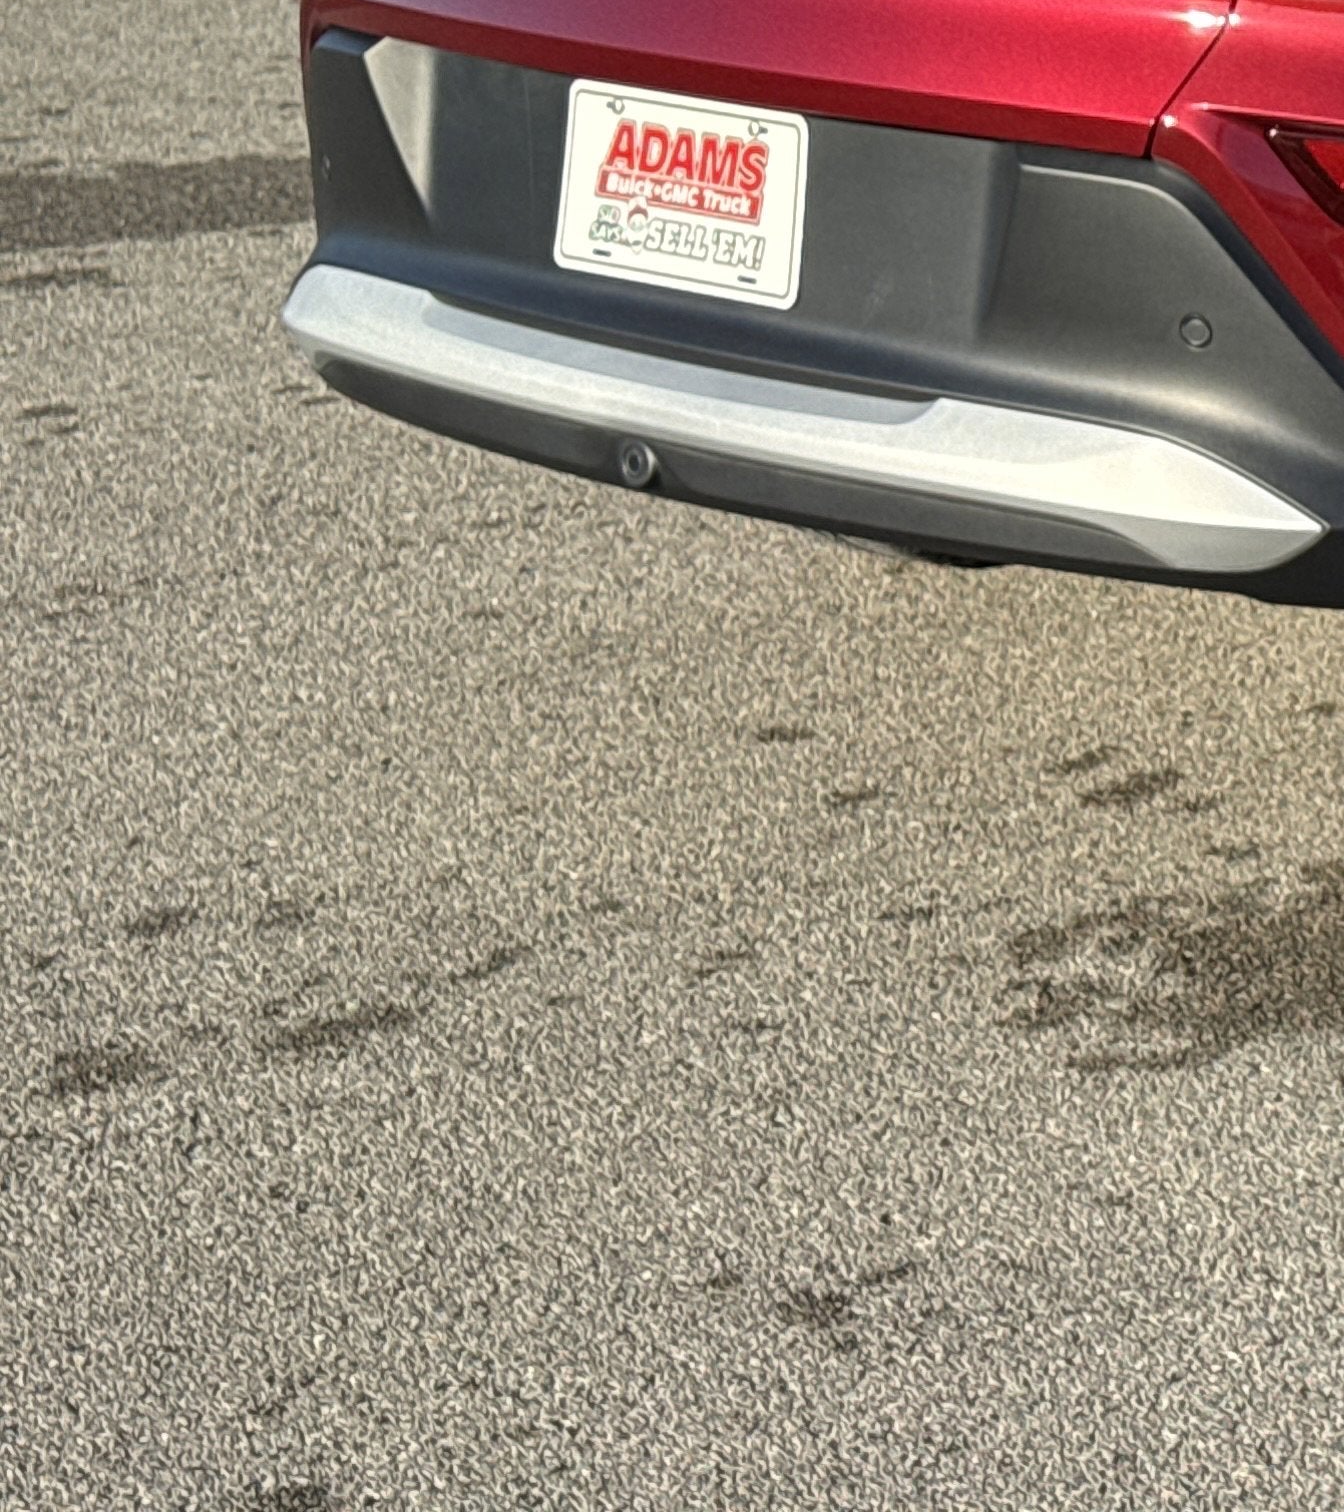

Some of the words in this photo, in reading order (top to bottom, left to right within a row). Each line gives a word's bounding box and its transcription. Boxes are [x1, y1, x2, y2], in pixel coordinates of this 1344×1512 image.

[604, 118, 769, 194] ADAMS
[703, 189, 752, 217] Truck
[643, 216, 710, 263] SELL
[711, 228, 767, 272] 'EM!
